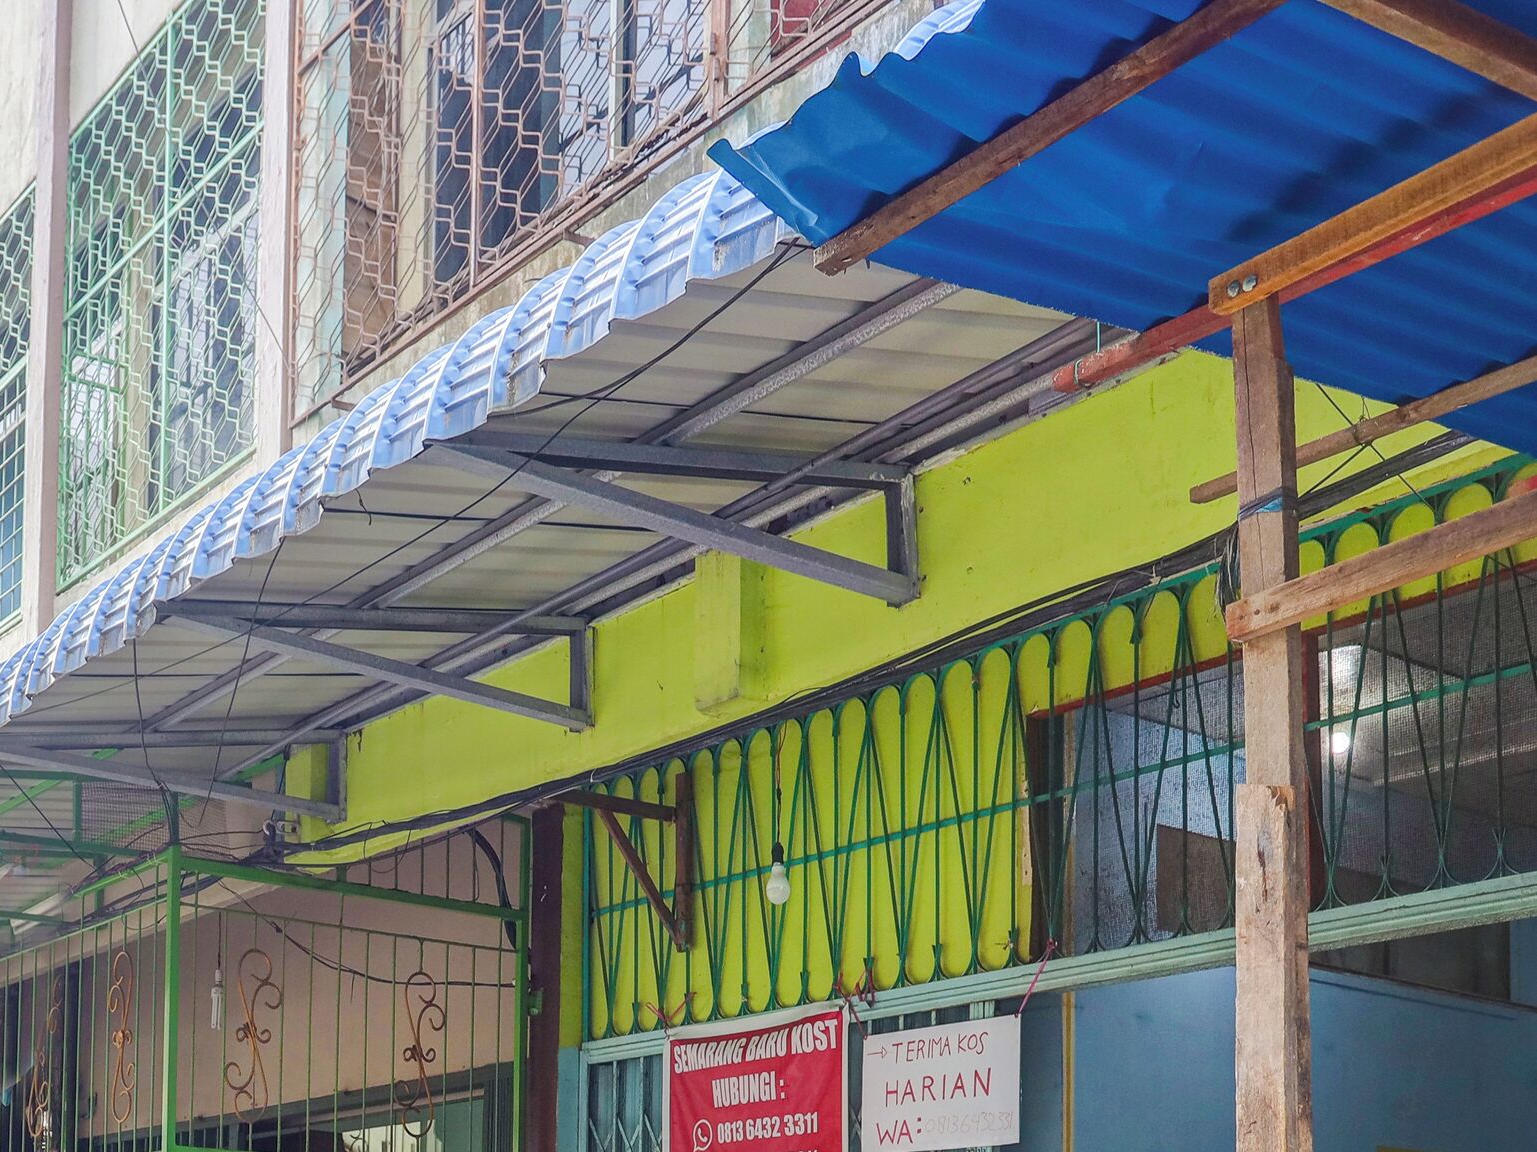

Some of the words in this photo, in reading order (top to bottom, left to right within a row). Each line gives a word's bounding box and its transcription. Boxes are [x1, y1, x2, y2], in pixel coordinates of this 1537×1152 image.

[673, 1036, 747, 1074] SEMARANG
[745, 1027, 789, 1062] BARU
[791, 1018, 838, 1055] KOST
[892, 1036, 951, 1064] TERIMA
[957, 1031, 989, 1055] KOS
[711, 1071, 777, 1109] HUBUNGI
[885, 1067, 992, 1107] HARIAN
[717, 1121, 744, 1144] 0813
[746, 1116, 782, 1140] 6432
[783, 1111, 818, 1136] 3311
